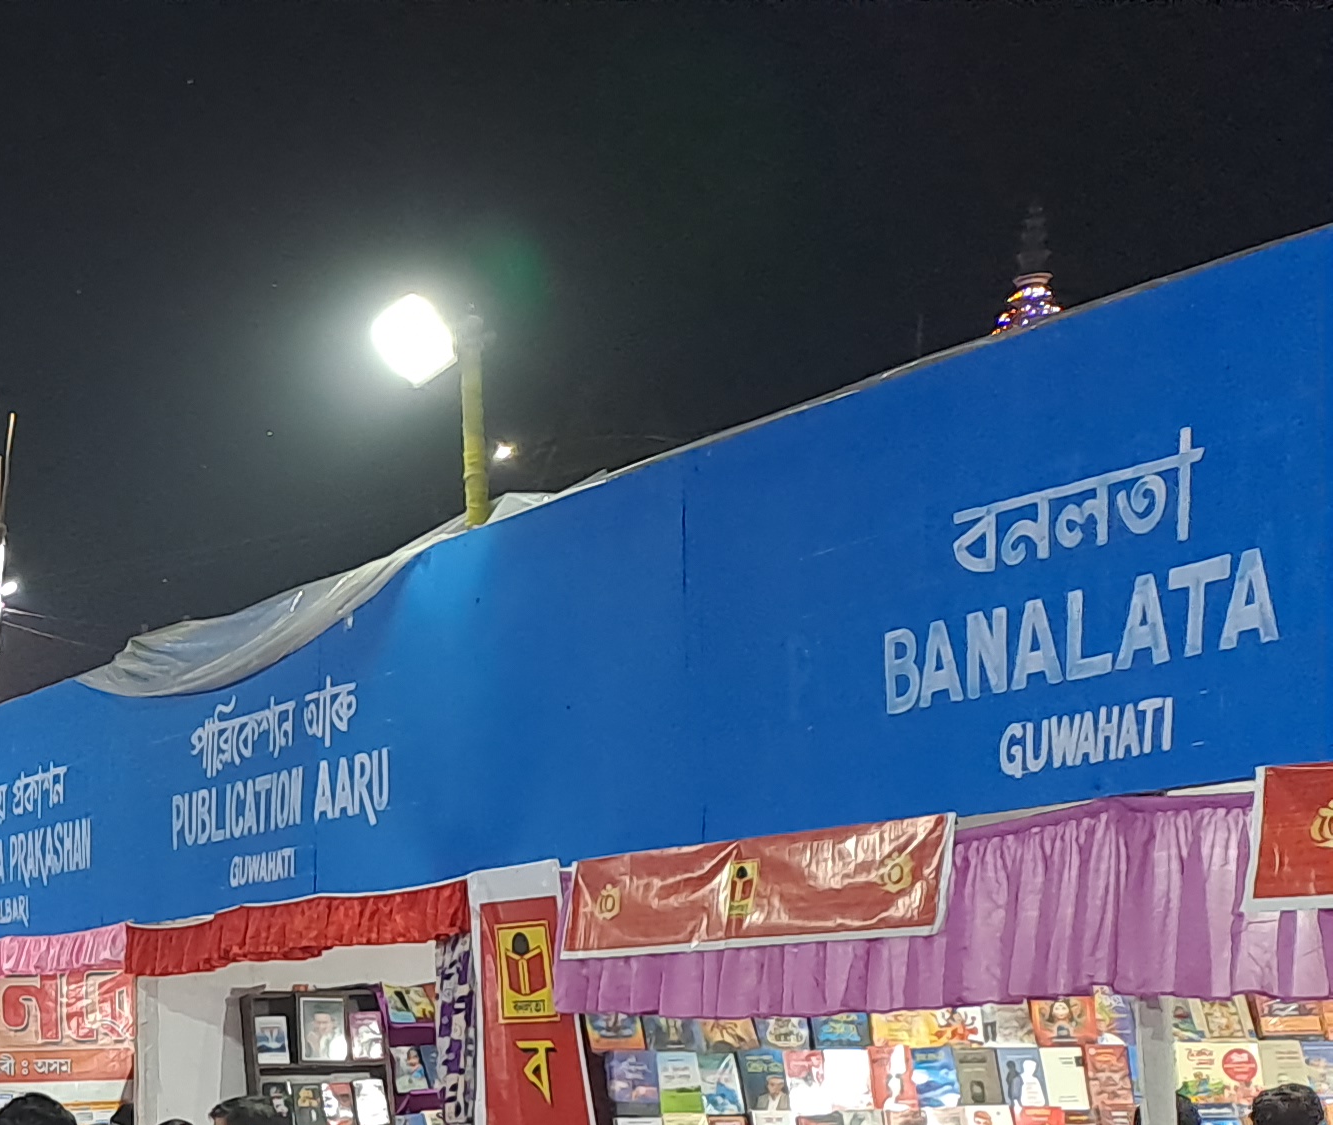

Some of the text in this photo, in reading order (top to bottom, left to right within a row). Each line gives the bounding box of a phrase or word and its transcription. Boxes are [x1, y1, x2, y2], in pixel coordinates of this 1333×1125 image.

[952, 426, 1205, 573] বনলতা
[883, 547, 1280, 716] BANALATA
[999, 696, 1174, 779] GUWAHATI
[171, 747, 391, 851] PUBLICATION AARU
[9, 817, 92, 889] PRAKASHAN
[229, 847, 296, 888] GUWAHATI
[33, 1058, 72, 1075] অসম
